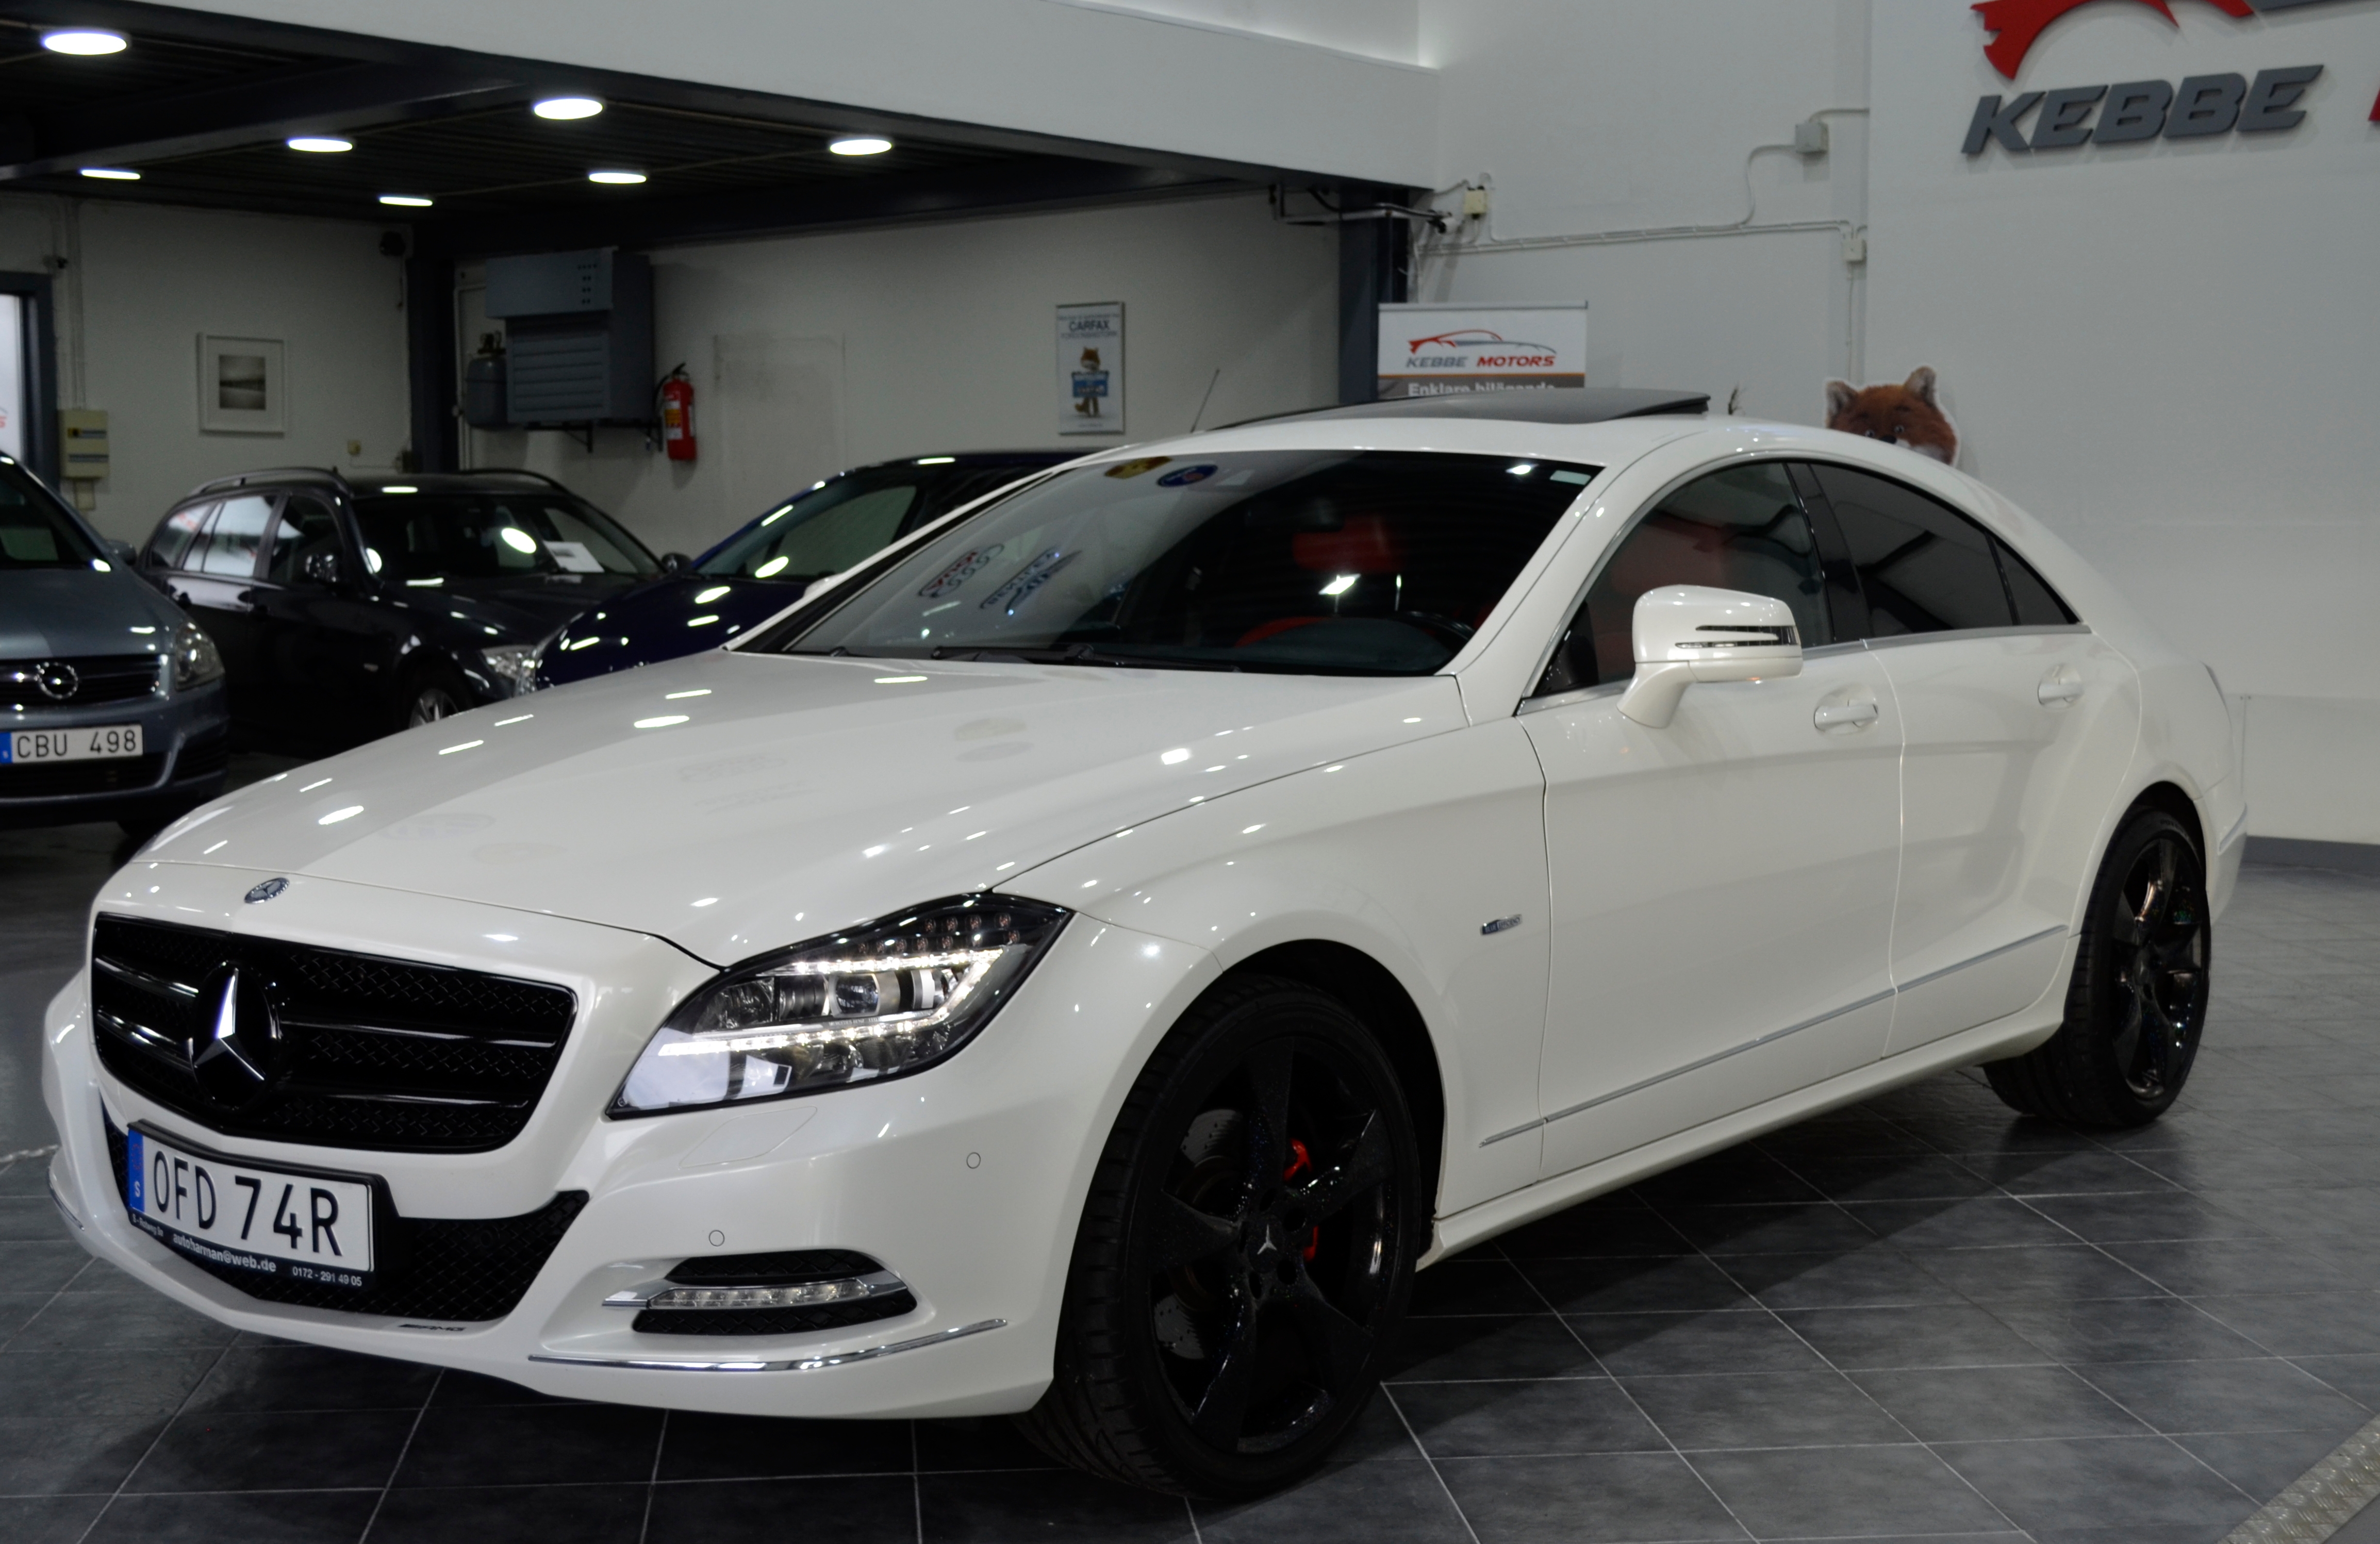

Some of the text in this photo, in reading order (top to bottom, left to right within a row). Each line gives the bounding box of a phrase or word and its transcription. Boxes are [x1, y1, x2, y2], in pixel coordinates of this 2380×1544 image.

[1961, 64, 2324, 156] KEBBE
[1068, 319, 1110, 331] CARFAX
[1407, 356, 1556, 368] KEBBE MOTORS
[18, 729, 136, 758] CBU 498
[134, 1181, 141, 1198] S
[154, 1151, 343, 1256] OFD 74R
[173, 1233, 277, 1272] autoharman@web.de
[292, 1266, 313, 1279] 0172
[320, 1270, 336, 1283] 291
[338, 1274, 349, 1285] 49
[351, 1275, 362, 1287] 05
